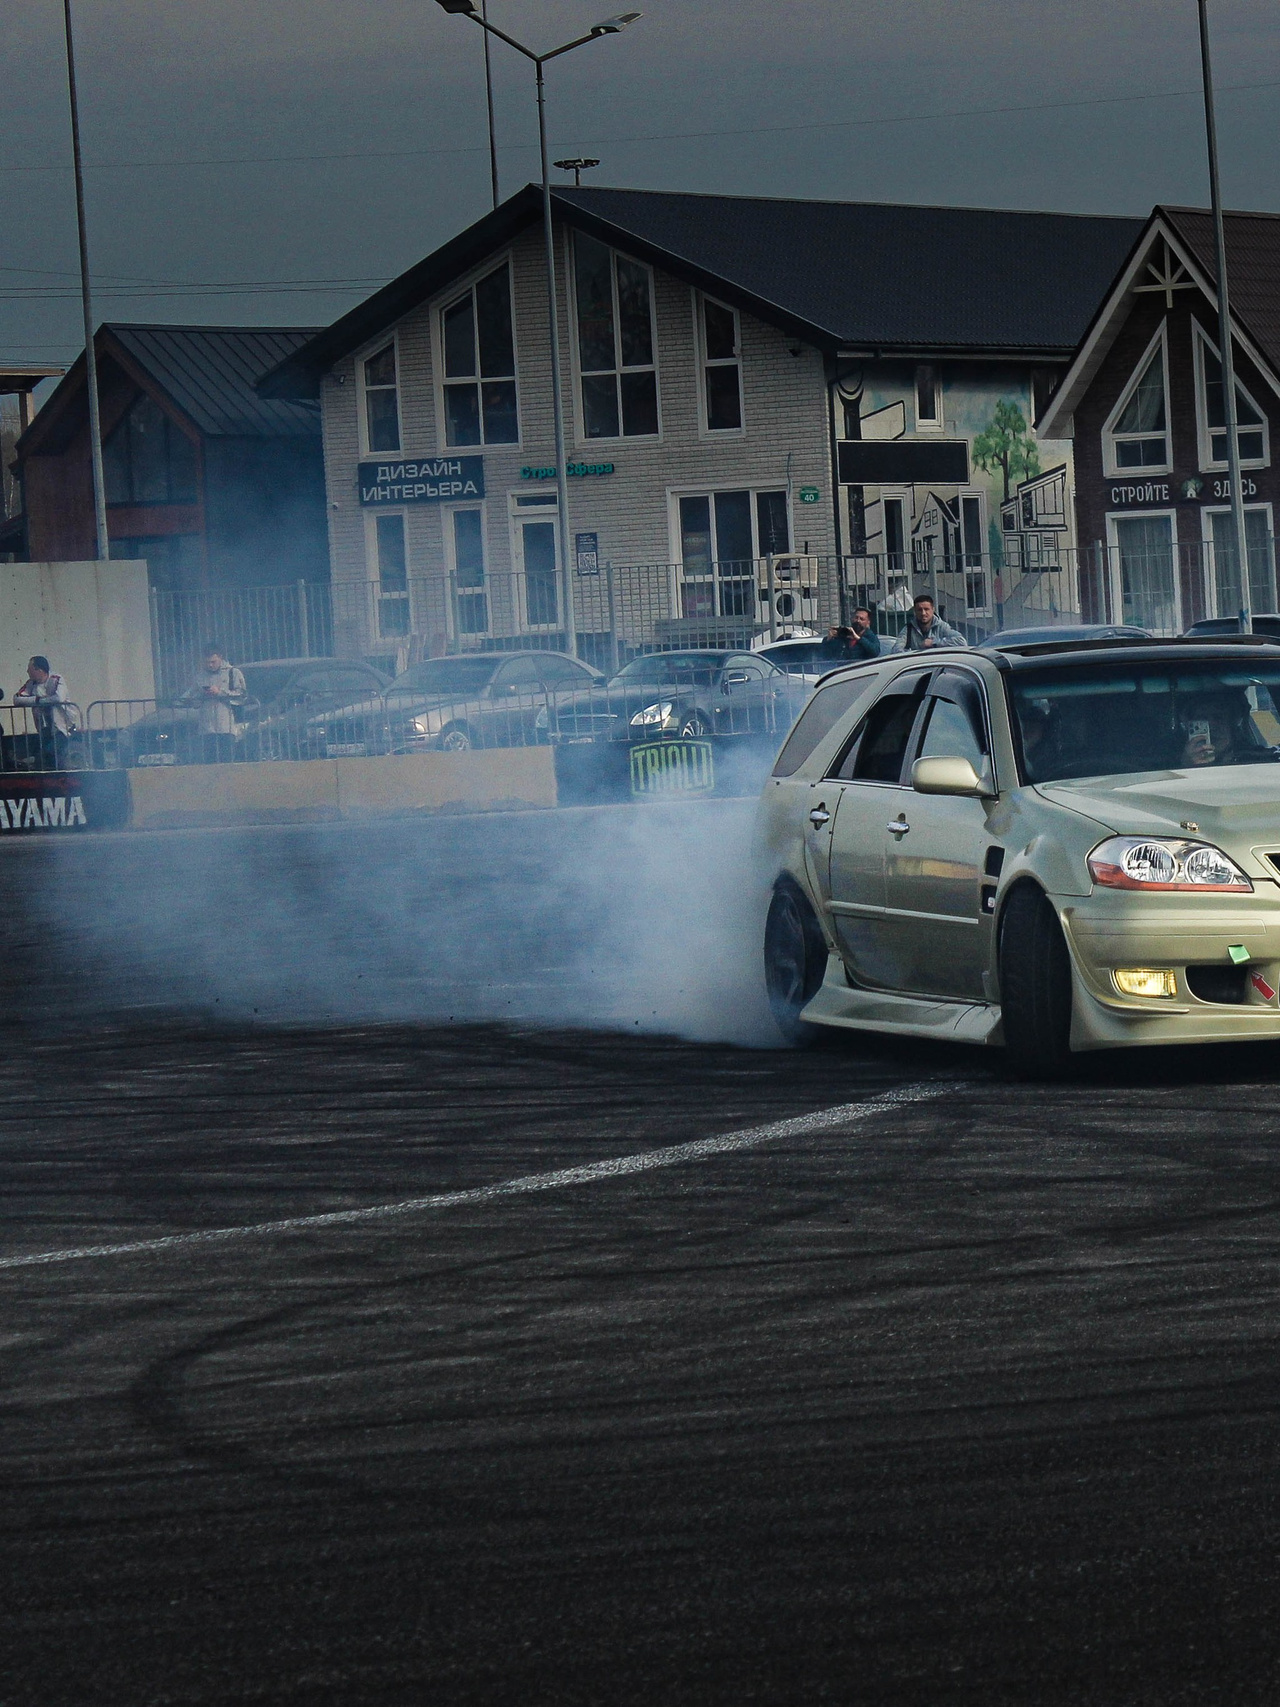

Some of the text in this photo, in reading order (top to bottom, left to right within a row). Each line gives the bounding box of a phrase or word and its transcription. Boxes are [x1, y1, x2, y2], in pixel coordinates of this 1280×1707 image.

[377, 459, 462, 483] ДИЗАЙН
[521, 462, 615, 480] СтроСфера
[362, 481, 478, 501] ИНТЕРЬЕРА
[804, 493, 815, 502] 40
[1111, 478, 1257, 503] СТРОЙТЕ ЗДСЬ
